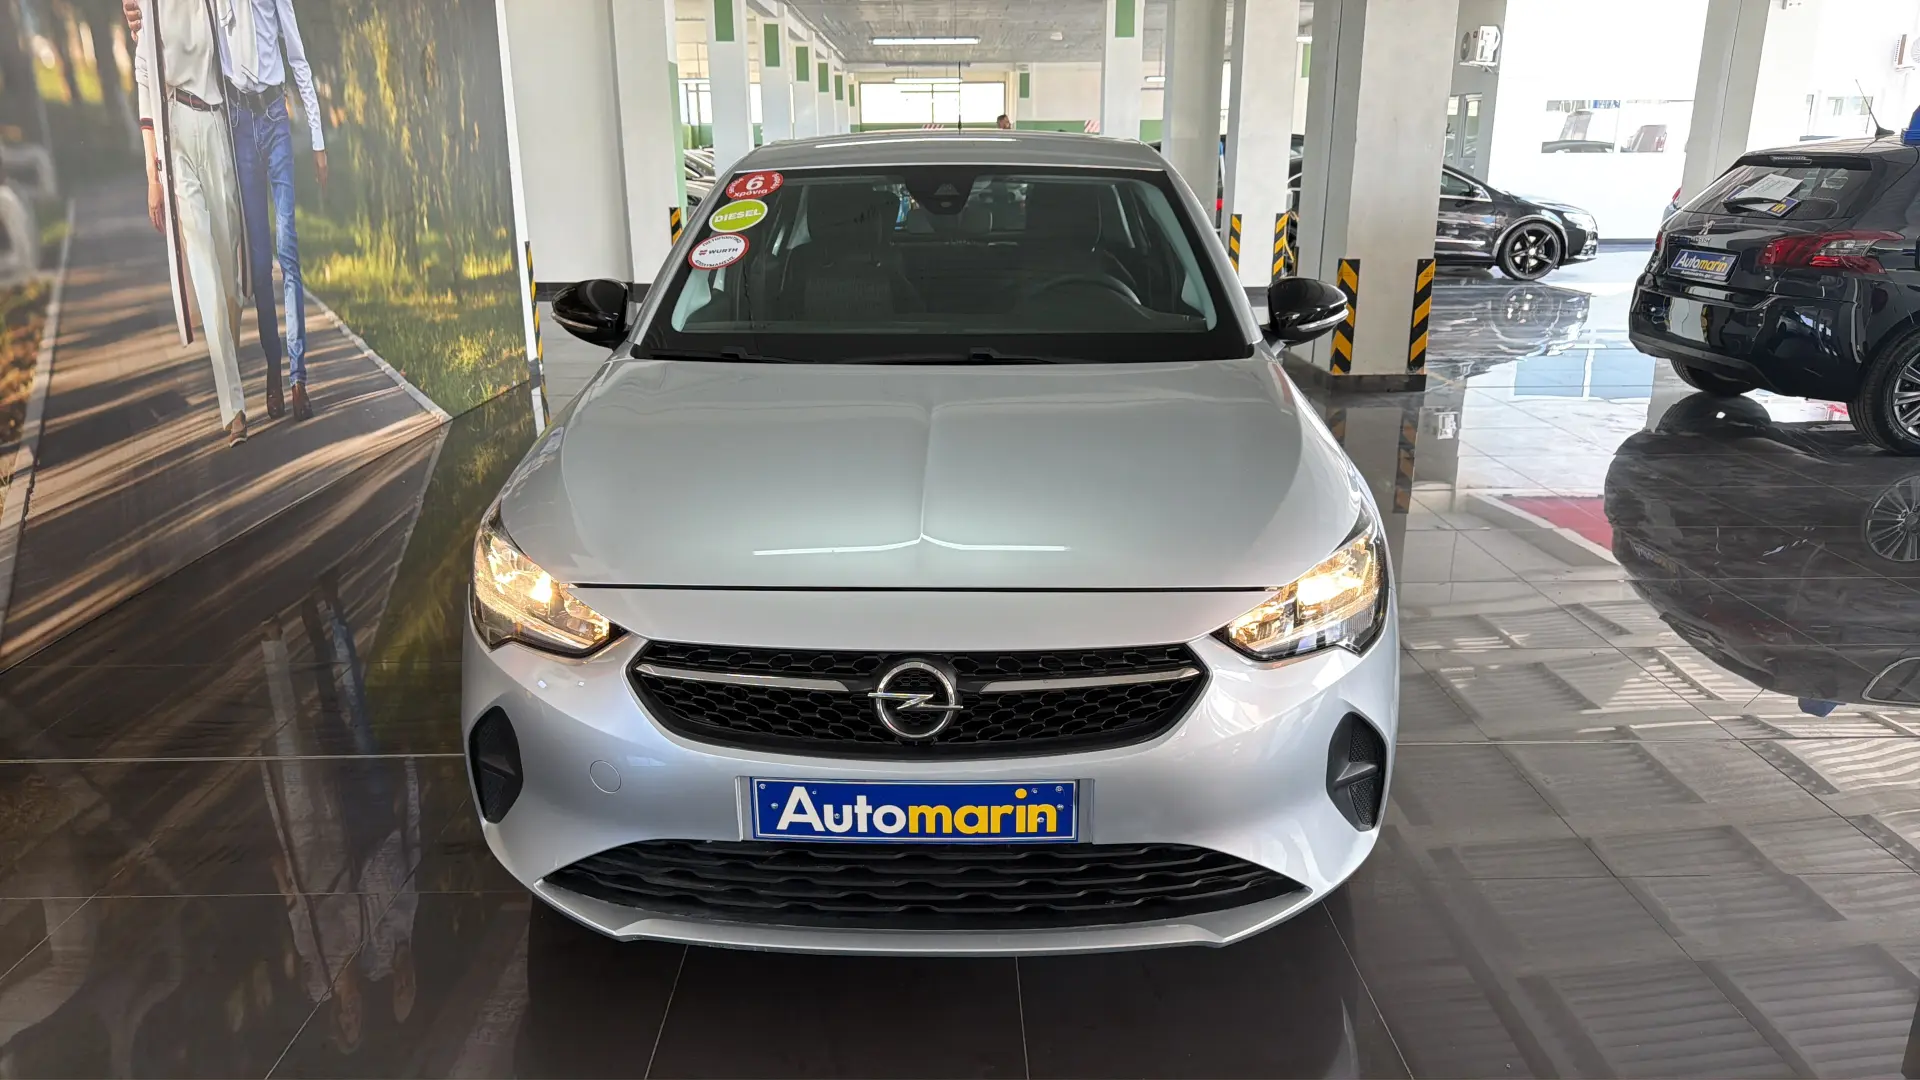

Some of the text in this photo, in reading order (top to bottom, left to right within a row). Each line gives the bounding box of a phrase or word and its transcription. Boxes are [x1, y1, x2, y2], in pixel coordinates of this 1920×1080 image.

[745, 175, 765, 190] 6
[733, 189, 768, 198] χρόνια
[714, 208, 761, 223] DIESEL
[1675, 252, 1728, 272] Automarin
[776, 786, 1057, 834] Automarin
